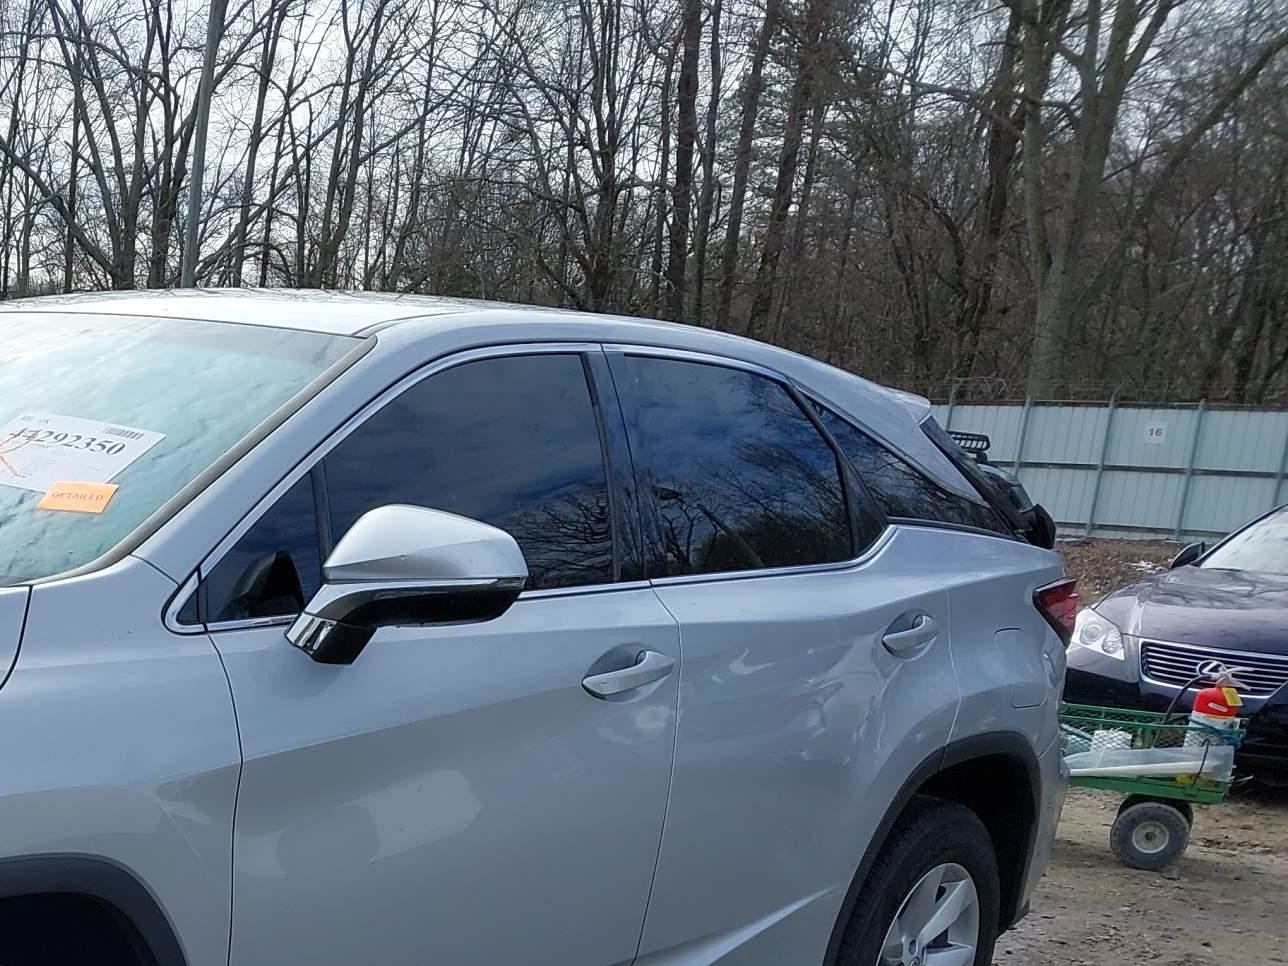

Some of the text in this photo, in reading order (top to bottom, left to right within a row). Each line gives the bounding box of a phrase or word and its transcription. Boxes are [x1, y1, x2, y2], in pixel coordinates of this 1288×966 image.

[1149, 427, 1162, 437] 16
[8, 427, 126, 456] 44292350
[51, 490, 104, 501] DETAILED
